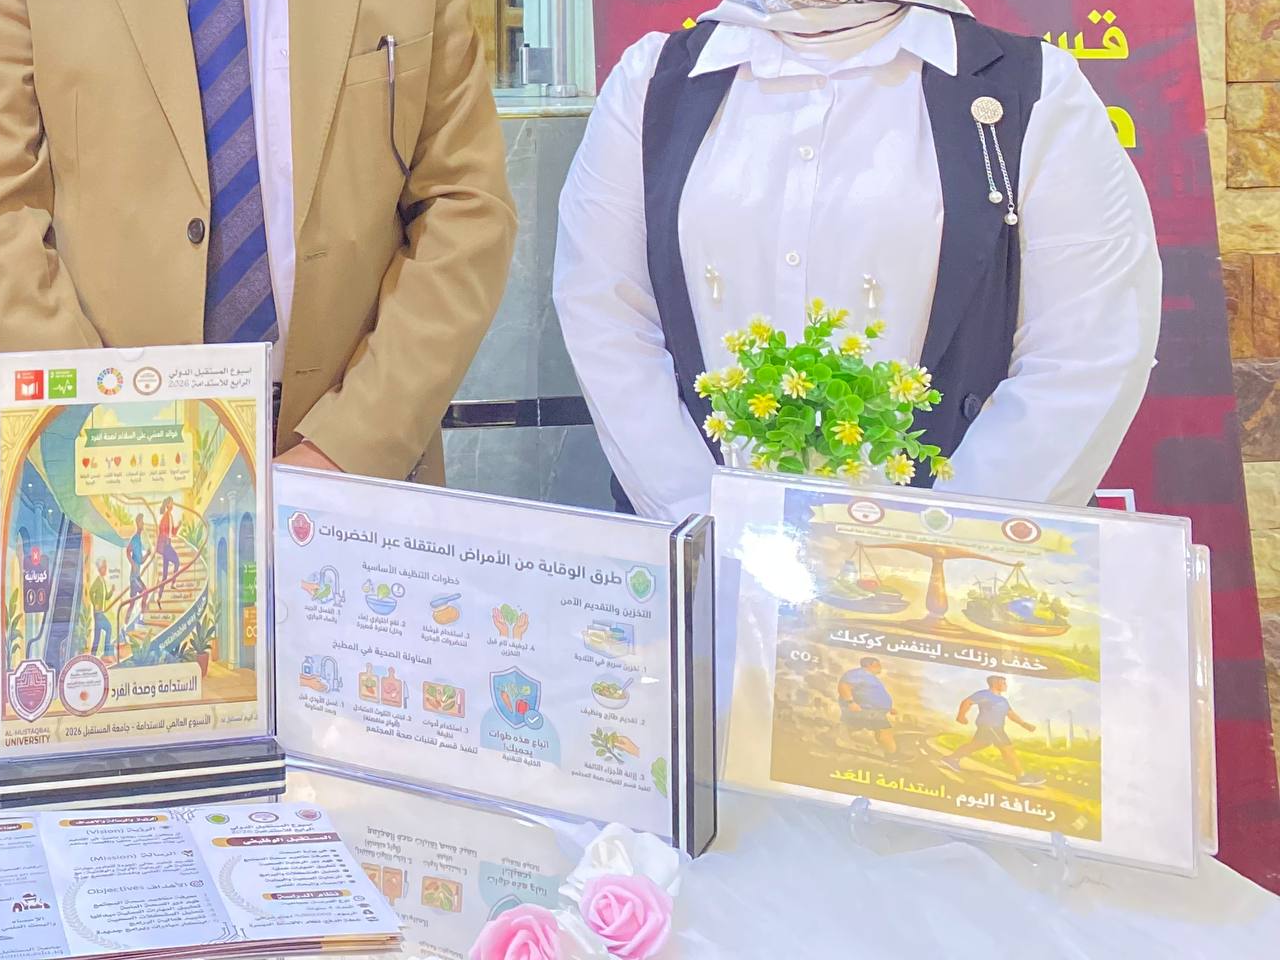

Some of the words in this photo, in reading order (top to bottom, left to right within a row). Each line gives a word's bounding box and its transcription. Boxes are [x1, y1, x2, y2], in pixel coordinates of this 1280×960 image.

[168, 368, 193, 379] الدولي
[194, 367, 229, 377] المستقبل
[319, 524, 378, 545] الخضروات
[382, 532, 401, 549] عبر
[404, 535, 455, 558] المنتقلة
[459, 547, 511, 567] الأمراض
[515, 557, 535, 573] من
[361, 561, 397, 577] الأساسية
[398, 568, 434, 583] التنظيف
[540, 558, 585, 584] الوقاية
[590, 566, 622, 585] طرق
[435, 572, 461, 586] خطوات
[560, 597, 582, 609] الآمن
[583, 599, 620, 616] والتقديم
[619, 604, 652, 620] التخزين
[332, 639, 358, 653] المطبخ
[830, 630, 884, 649] كوكبك
[363, 646, 374, 657] في
[375, 647, 401, 661] الصحية
[403, 651, 432, 666] المناولة
[954, 649, 998, 667] وزنك
[111, 682, 131, 699] الفرد
[132, 680, 157, 698] وصحة
[157, 675, 198, 693] الاستدامة
[109, 723, 130, 734] جامعة
[165, 717, 188, 730] العالمي
[366, 725, 395, 738] المجتمع
[65, 727, 82, 737] 2026
[395, 731, 413, 741] صحة
[5, 734, 51, 747] UNIVERSITY
[955, 792, 995, 808] اليوم
